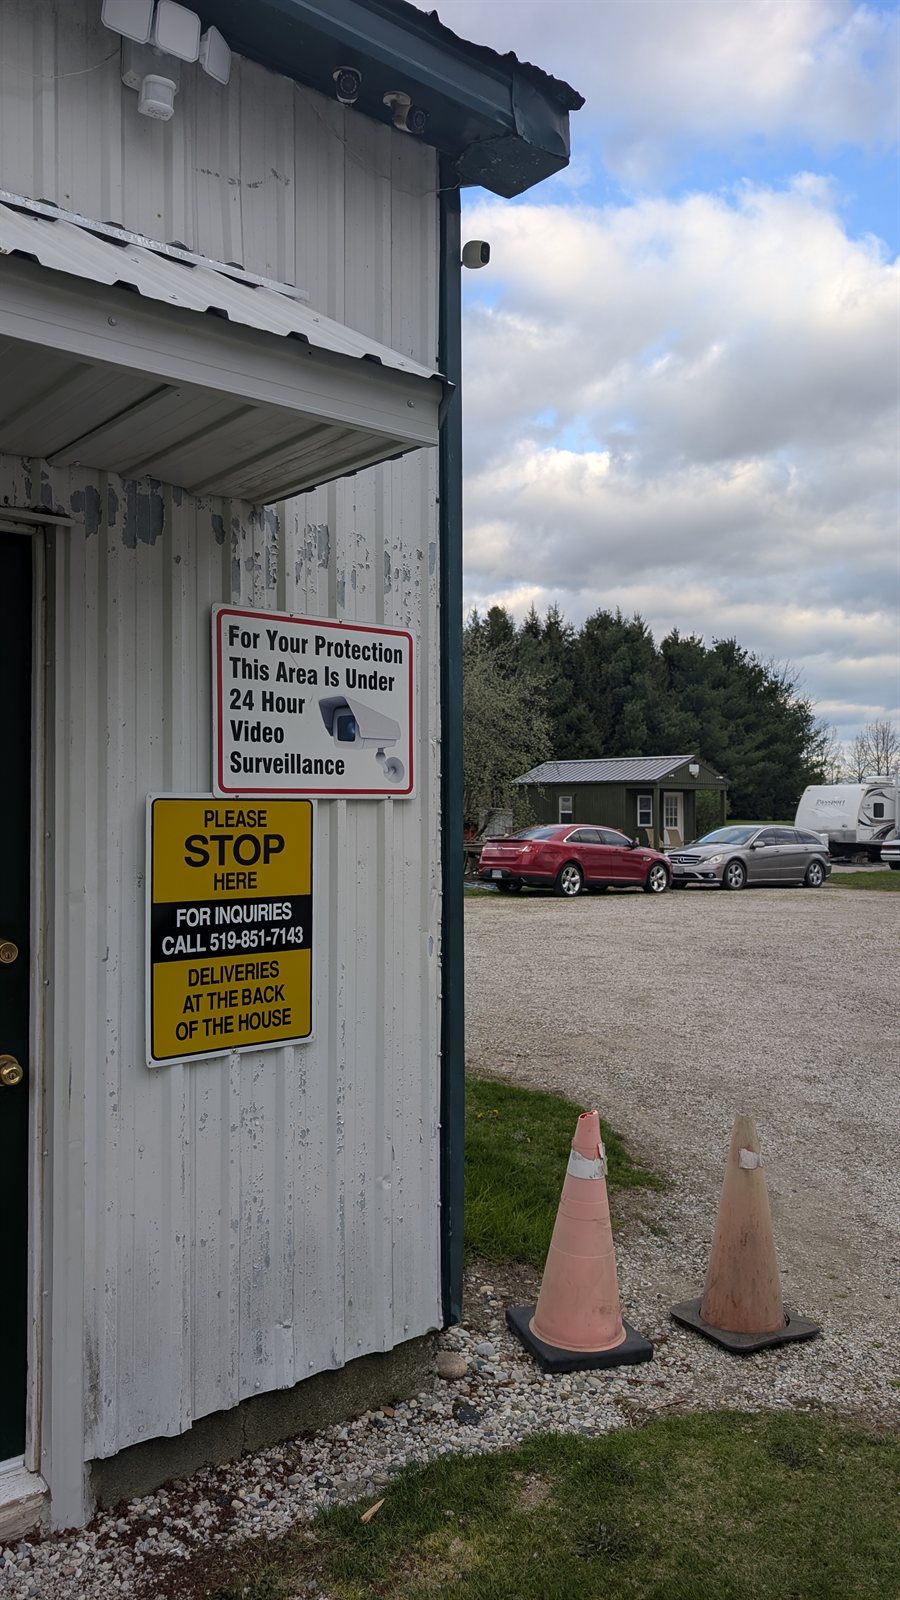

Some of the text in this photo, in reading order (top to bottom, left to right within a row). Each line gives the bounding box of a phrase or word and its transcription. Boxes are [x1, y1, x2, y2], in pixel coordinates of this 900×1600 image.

[229, 626, 403, 664] For Your Protection
[229, 657, 395, 692] This Area Is Under
[230, 689, 305, 714] 24 Hour
[231, 720, 284, 744] Video
[231, 751, 345, 775] Surveillance
[204, 810, 267, 828] PLEASE
[184, 834, 285, 868] STOP
[214, 872, 257, 891] HERE
[176, 902, 292, 928] FOR INQUIRIES
[162, 927, 303, 956] CALL 519-851-7143
[188, 960, 279, 987] DELIVERIES
[183, 984, 285, 1014] AT THE BACK
[176, 1008, 292, 1041] OF THE HOUSE
